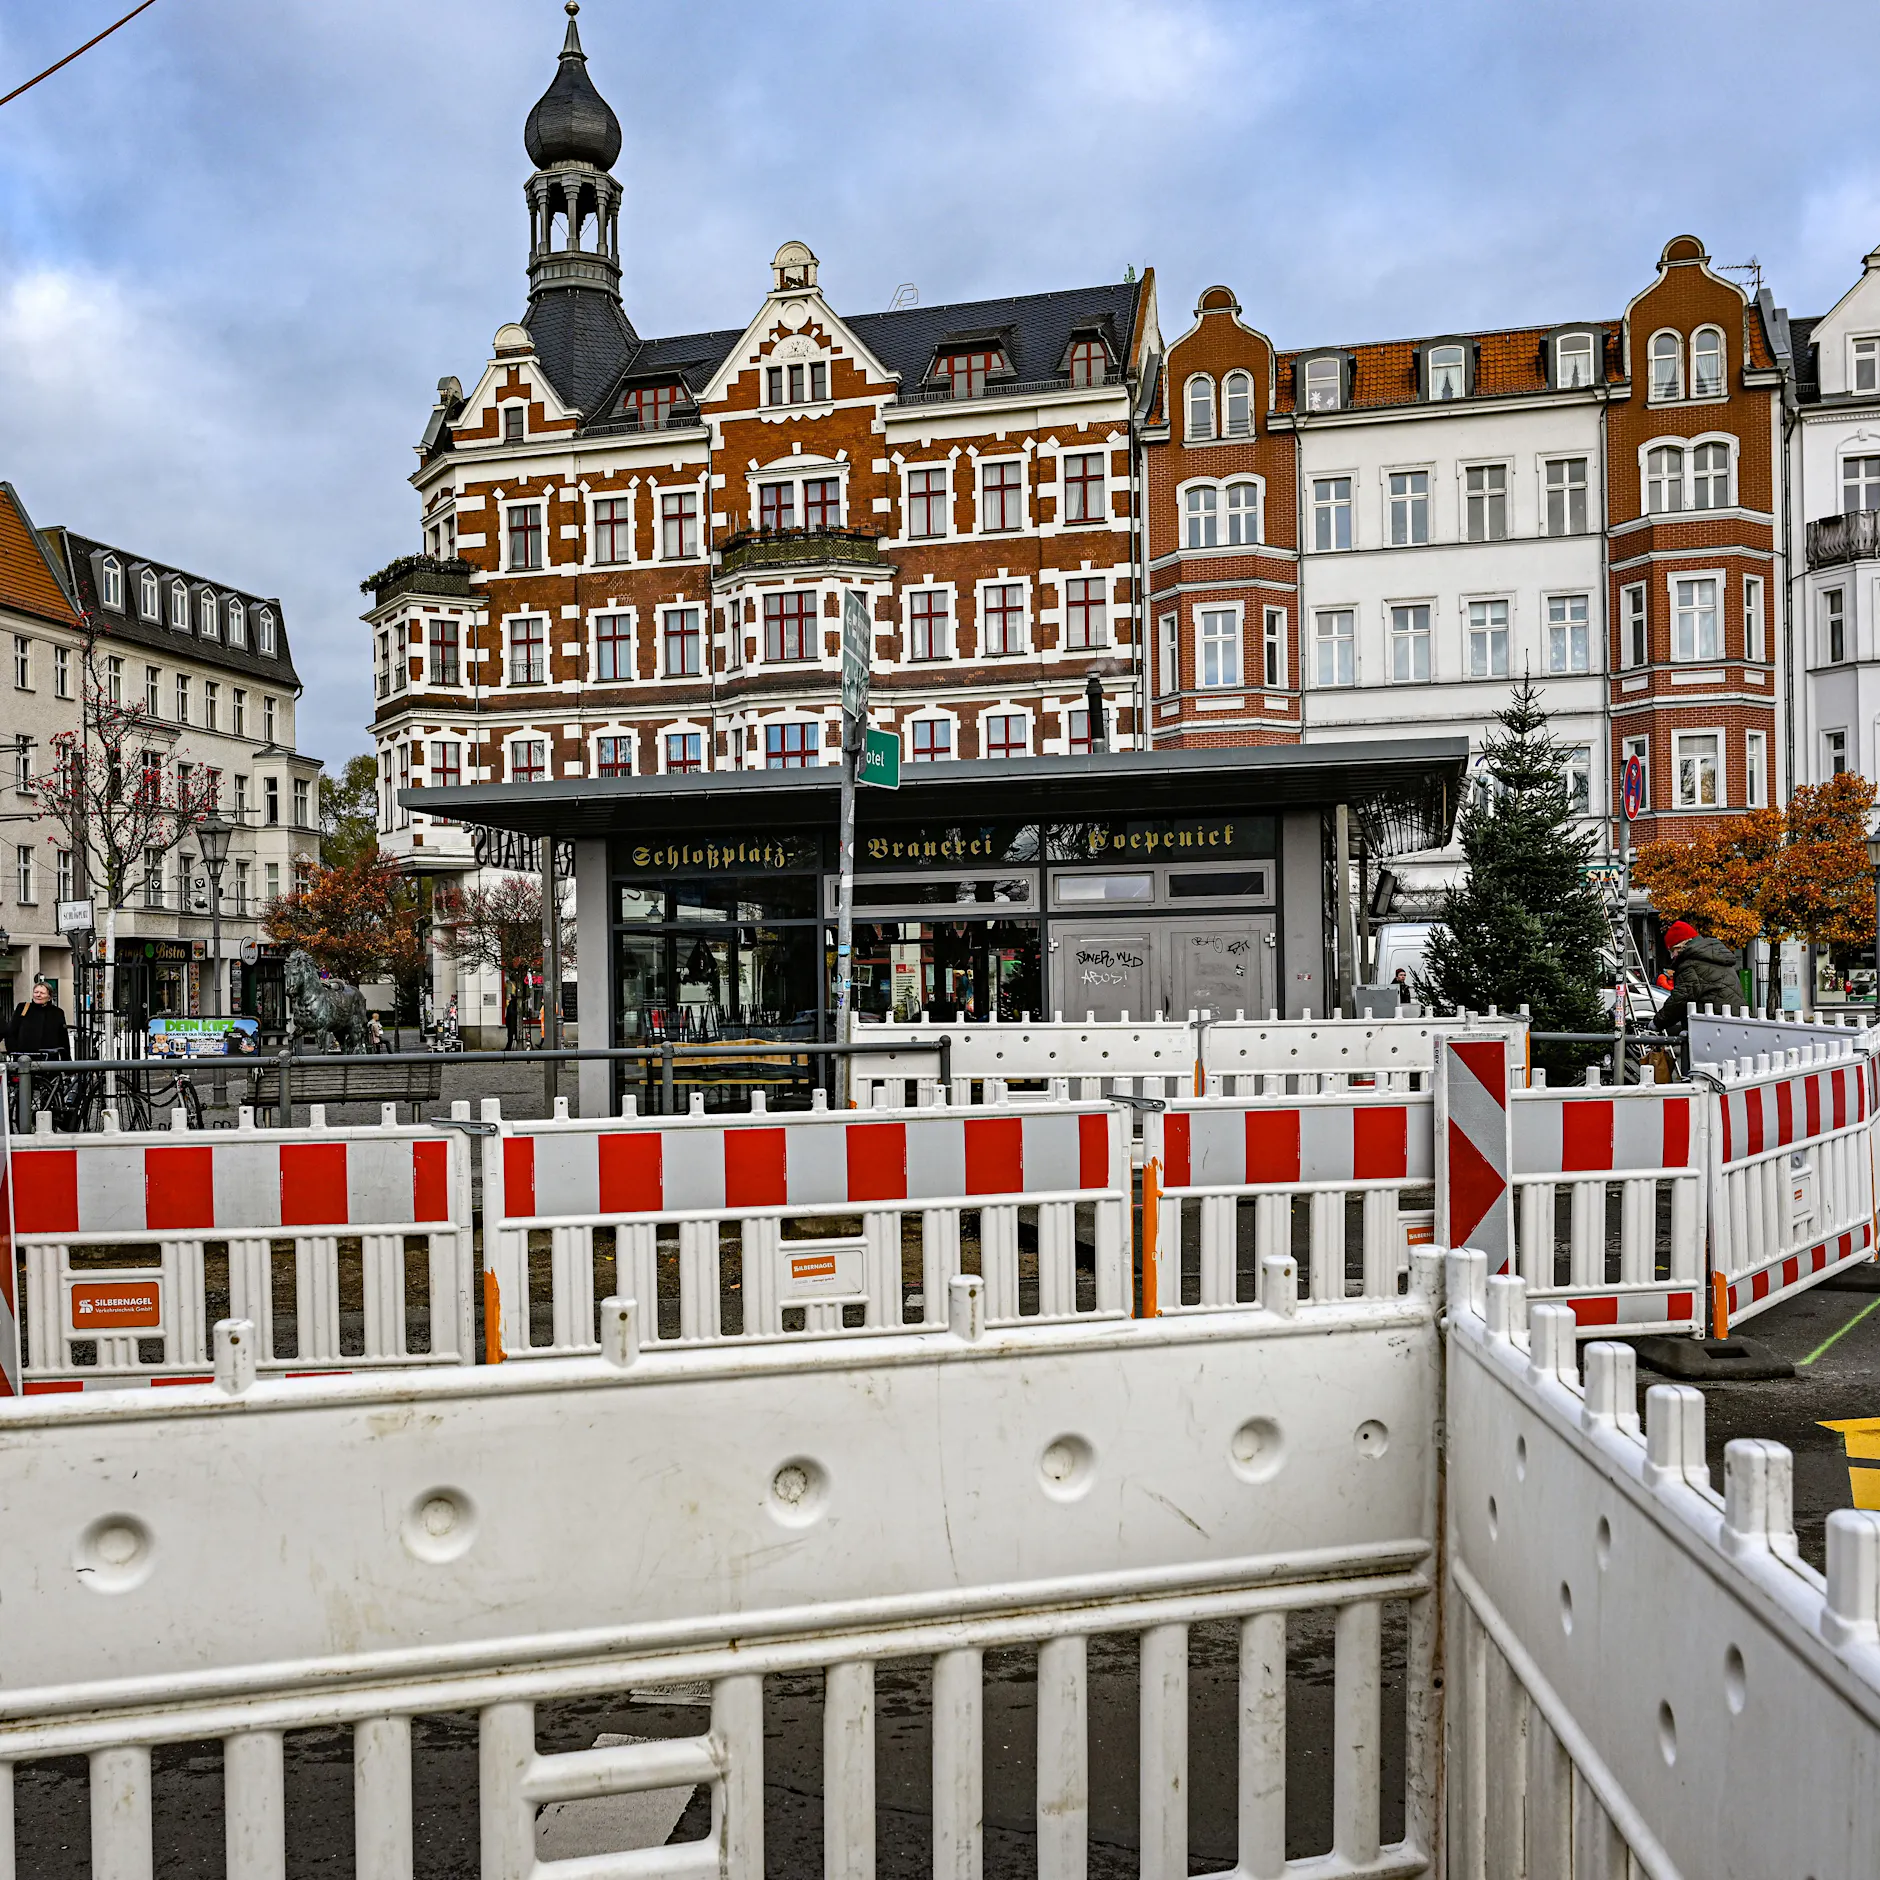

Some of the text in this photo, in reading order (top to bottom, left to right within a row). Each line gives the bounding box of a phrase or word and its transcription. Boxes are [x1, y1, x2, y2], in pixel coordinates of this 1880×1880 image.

[866, 750, 885, 767] otel
[867, 834, 993, 859] Brauerei
[1088, 823, 1234, 855] Coepenick
[1586, 868, 1620, 882] STA
[155, 941, 186, 960] Bistro
[164, 1019, 236, 1032] DEIN KIEZ
[793, 1262, 834, 1272] SILBERNAGEL
[94, 1297, 153, 1306] SILBERNAGEL
